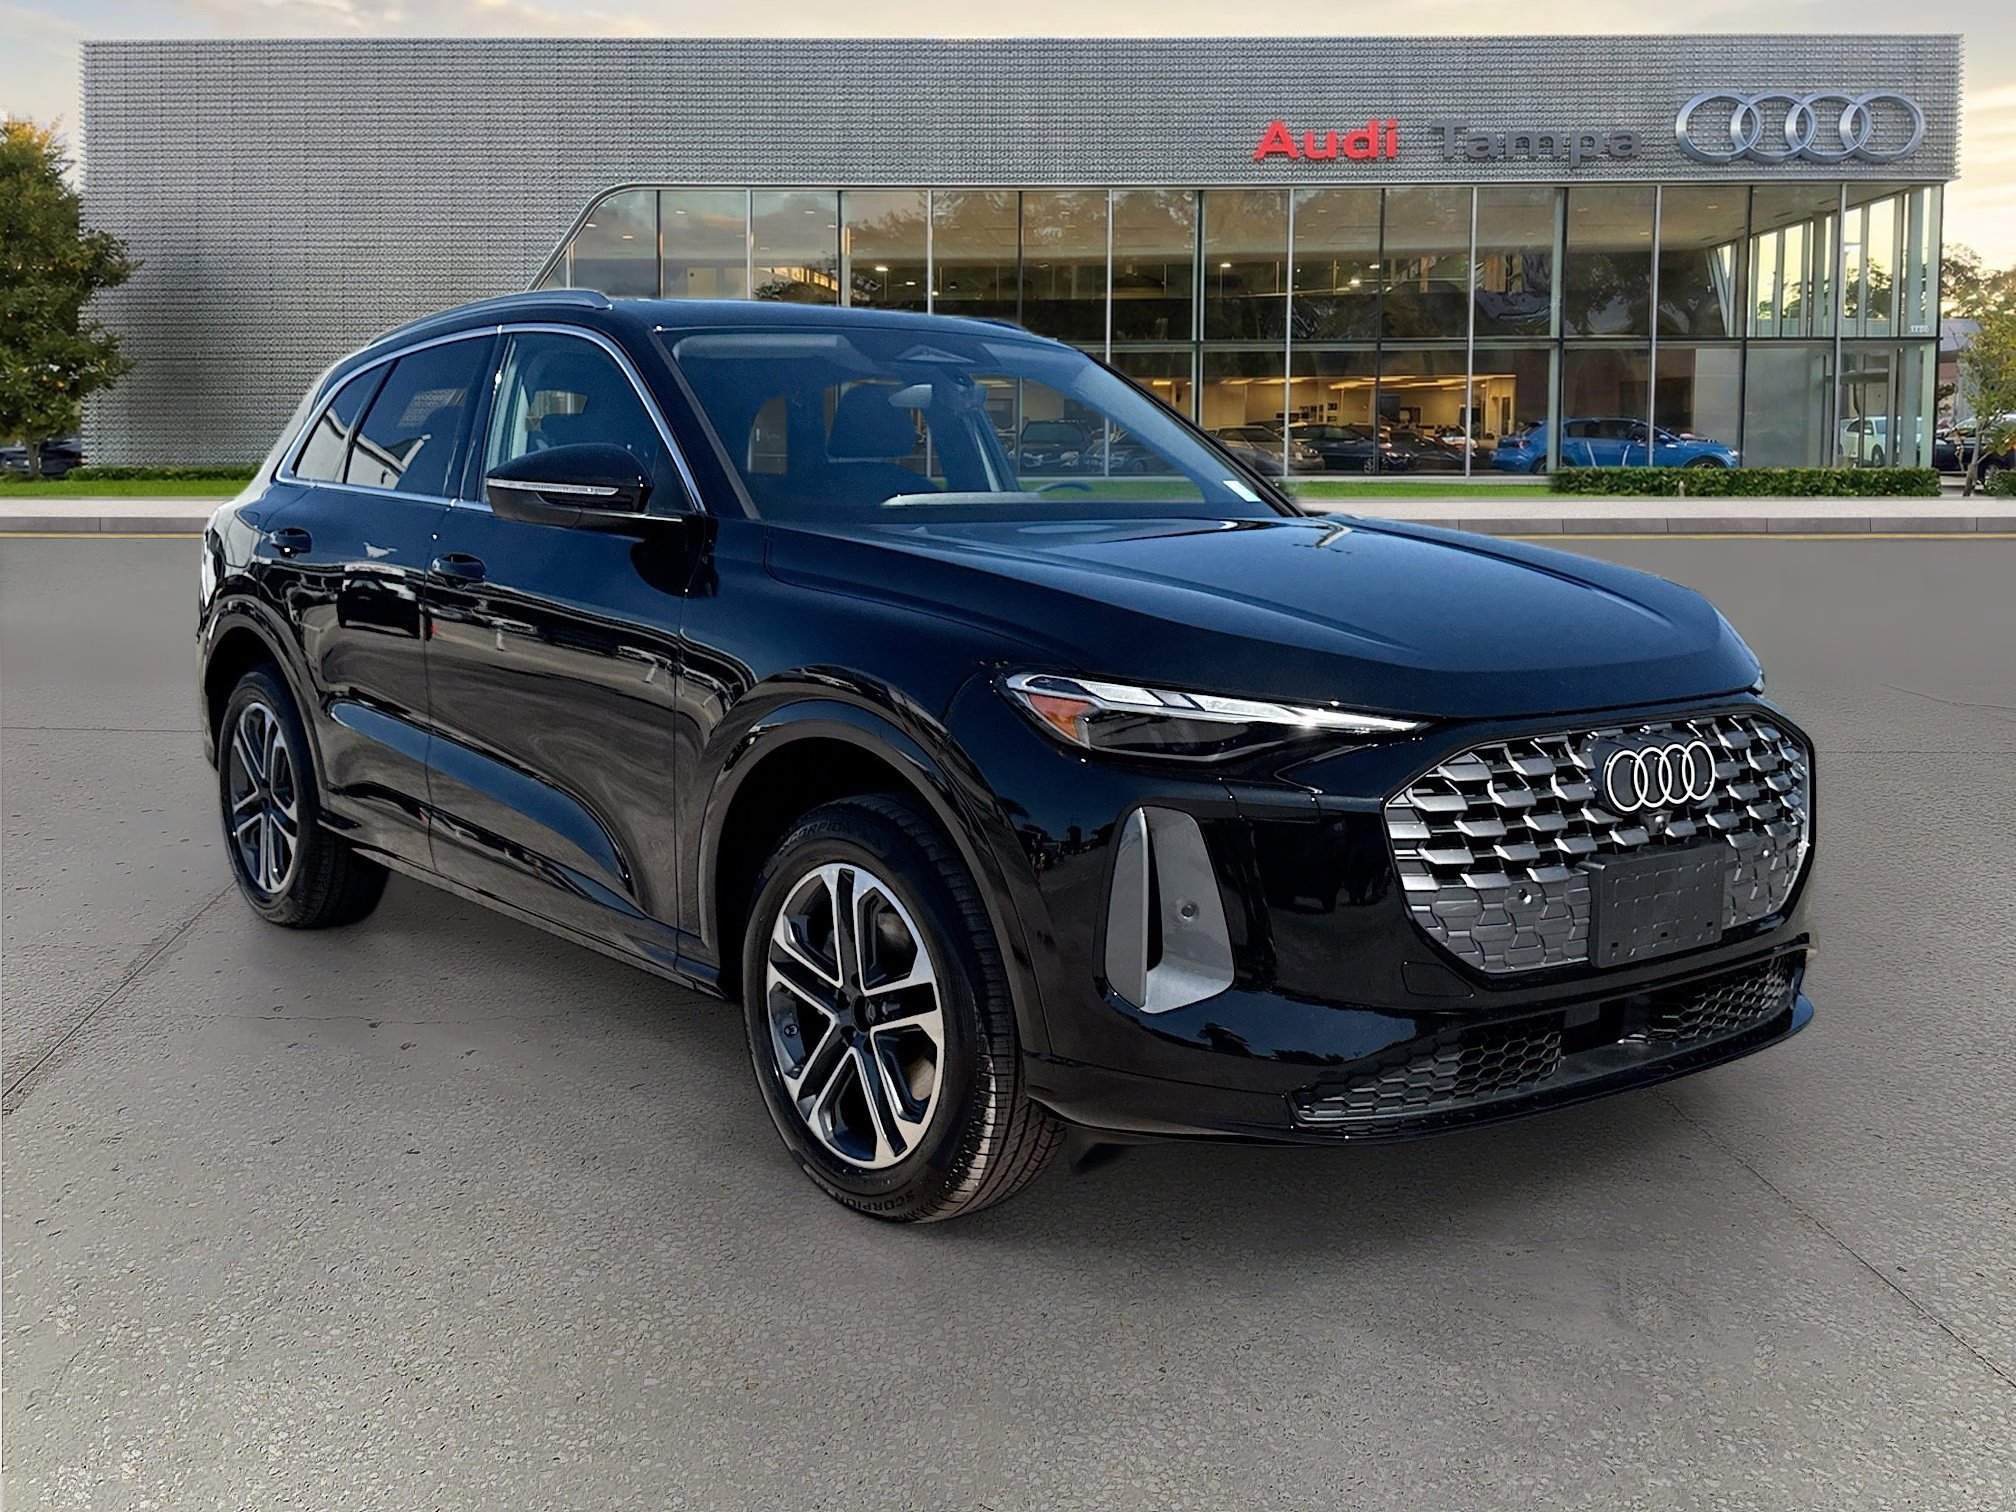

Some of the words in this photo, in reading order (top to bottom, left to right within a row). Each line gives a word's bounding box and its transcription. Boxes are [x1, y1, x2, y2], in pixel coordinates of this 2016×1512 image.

[1254, 118, 1399, 161] Audi
[1432, 117, 1643, 167] Tampa
[835, 1189, 915, 1211] SCORPION
